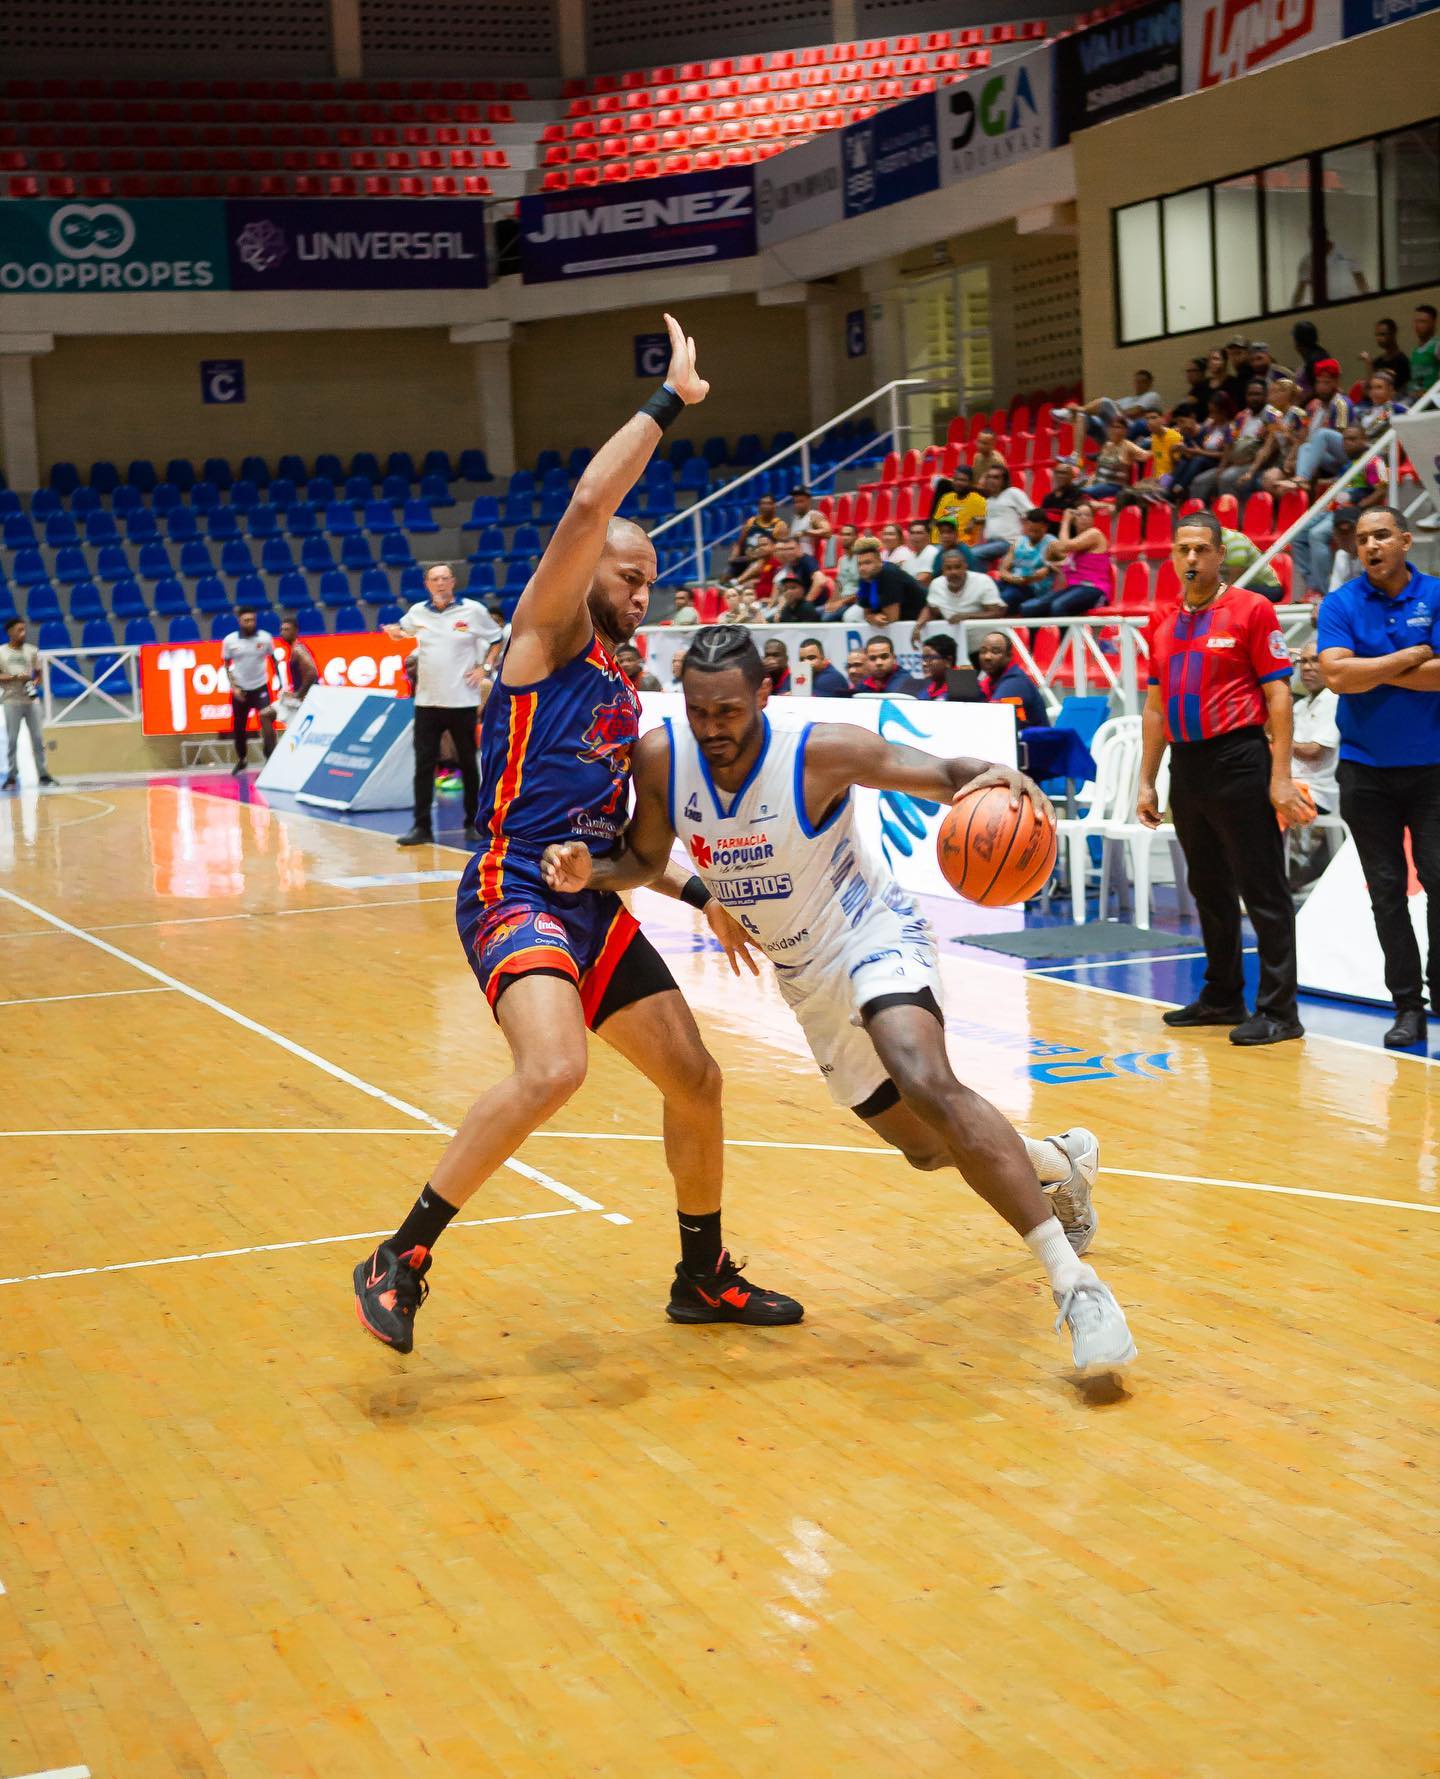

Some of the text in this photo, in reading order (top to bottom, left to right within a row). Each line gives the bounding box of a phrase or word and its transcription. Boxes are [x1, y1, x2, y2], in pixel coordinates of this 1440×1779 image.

[525, 186, 753, 244] JIMENEZ
[297, 231, 478, 260] UNIVERSAL
[848, 325, 863, 354] C
[641, 347, 666, 375] C
[210, 374, 237, 401] C
[712, 843, 775, 866] POPULAR
[716, 833, 768, 849] FARMACIA
[741, 914, 760, 934] 4
